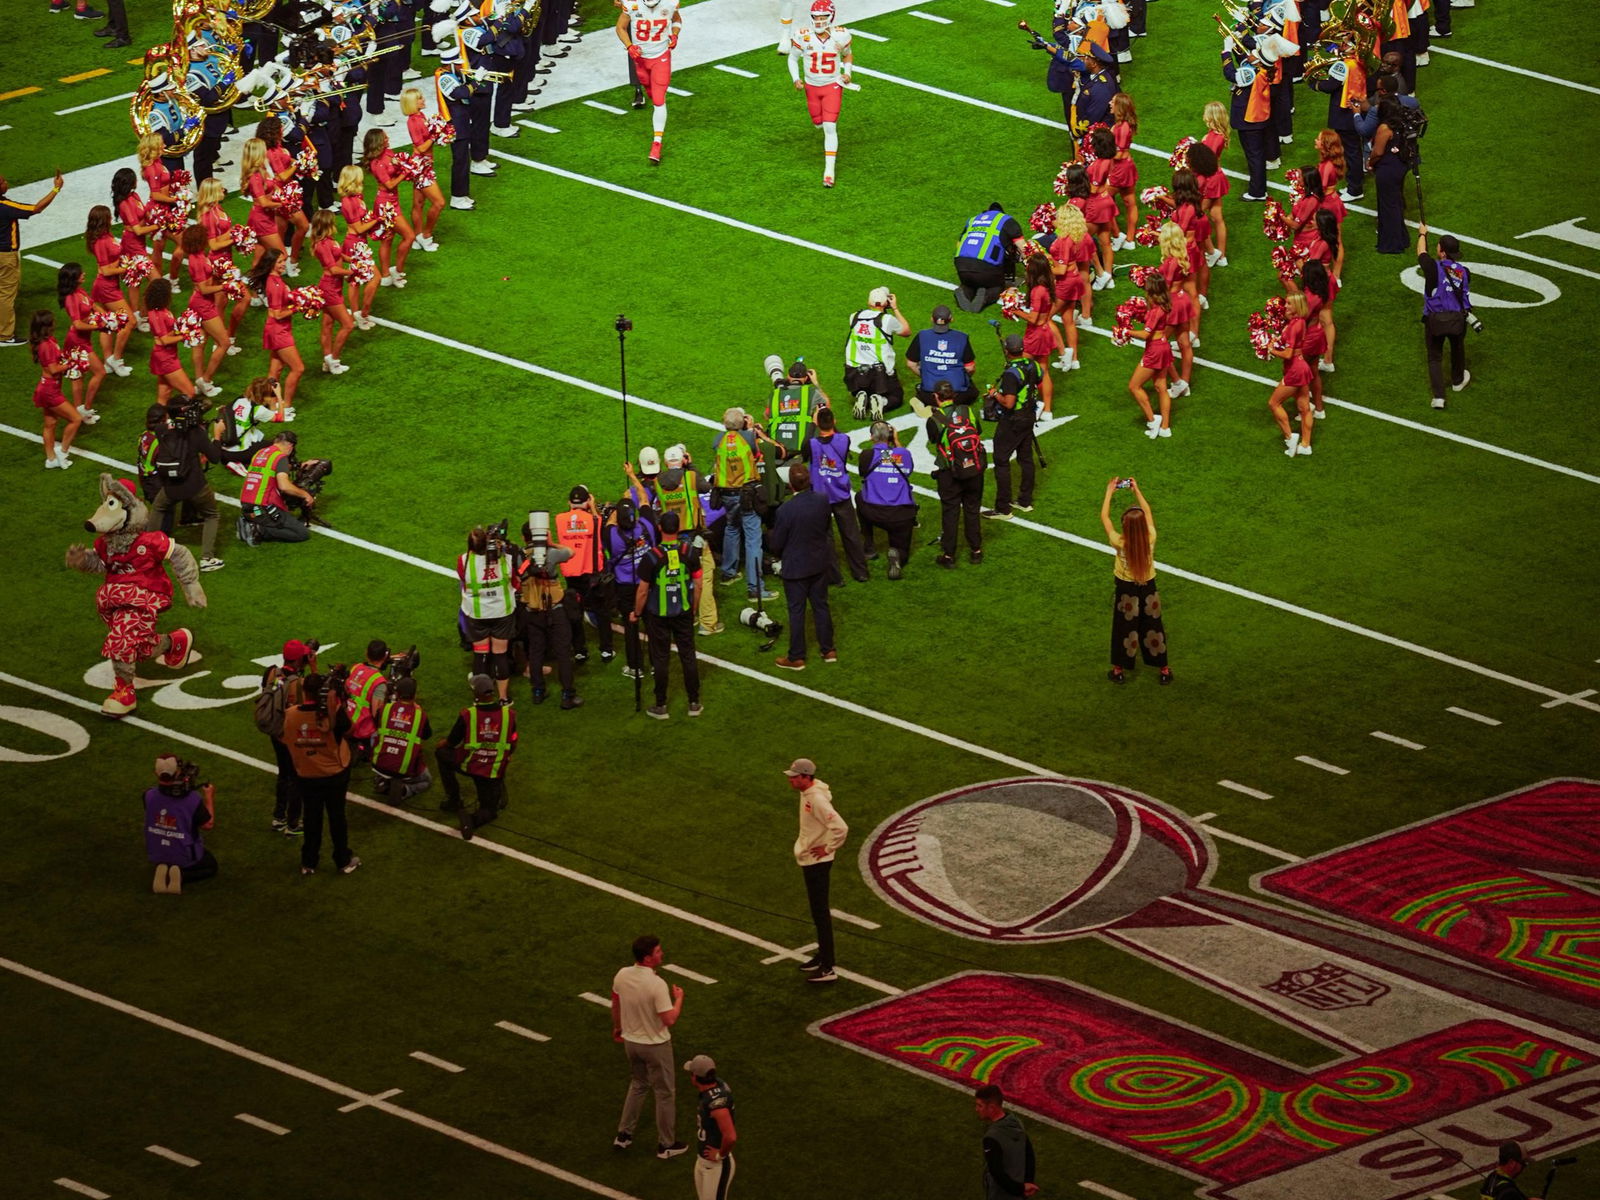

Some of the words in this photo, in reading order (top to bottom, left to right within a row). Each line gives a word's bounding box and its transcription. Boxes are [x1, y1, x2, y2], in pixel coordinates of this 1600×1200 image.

[636, 19, 668, 42] 87
[809, 52, 836, 74] 15
[1295, 979, 1380, 1009] NFL
